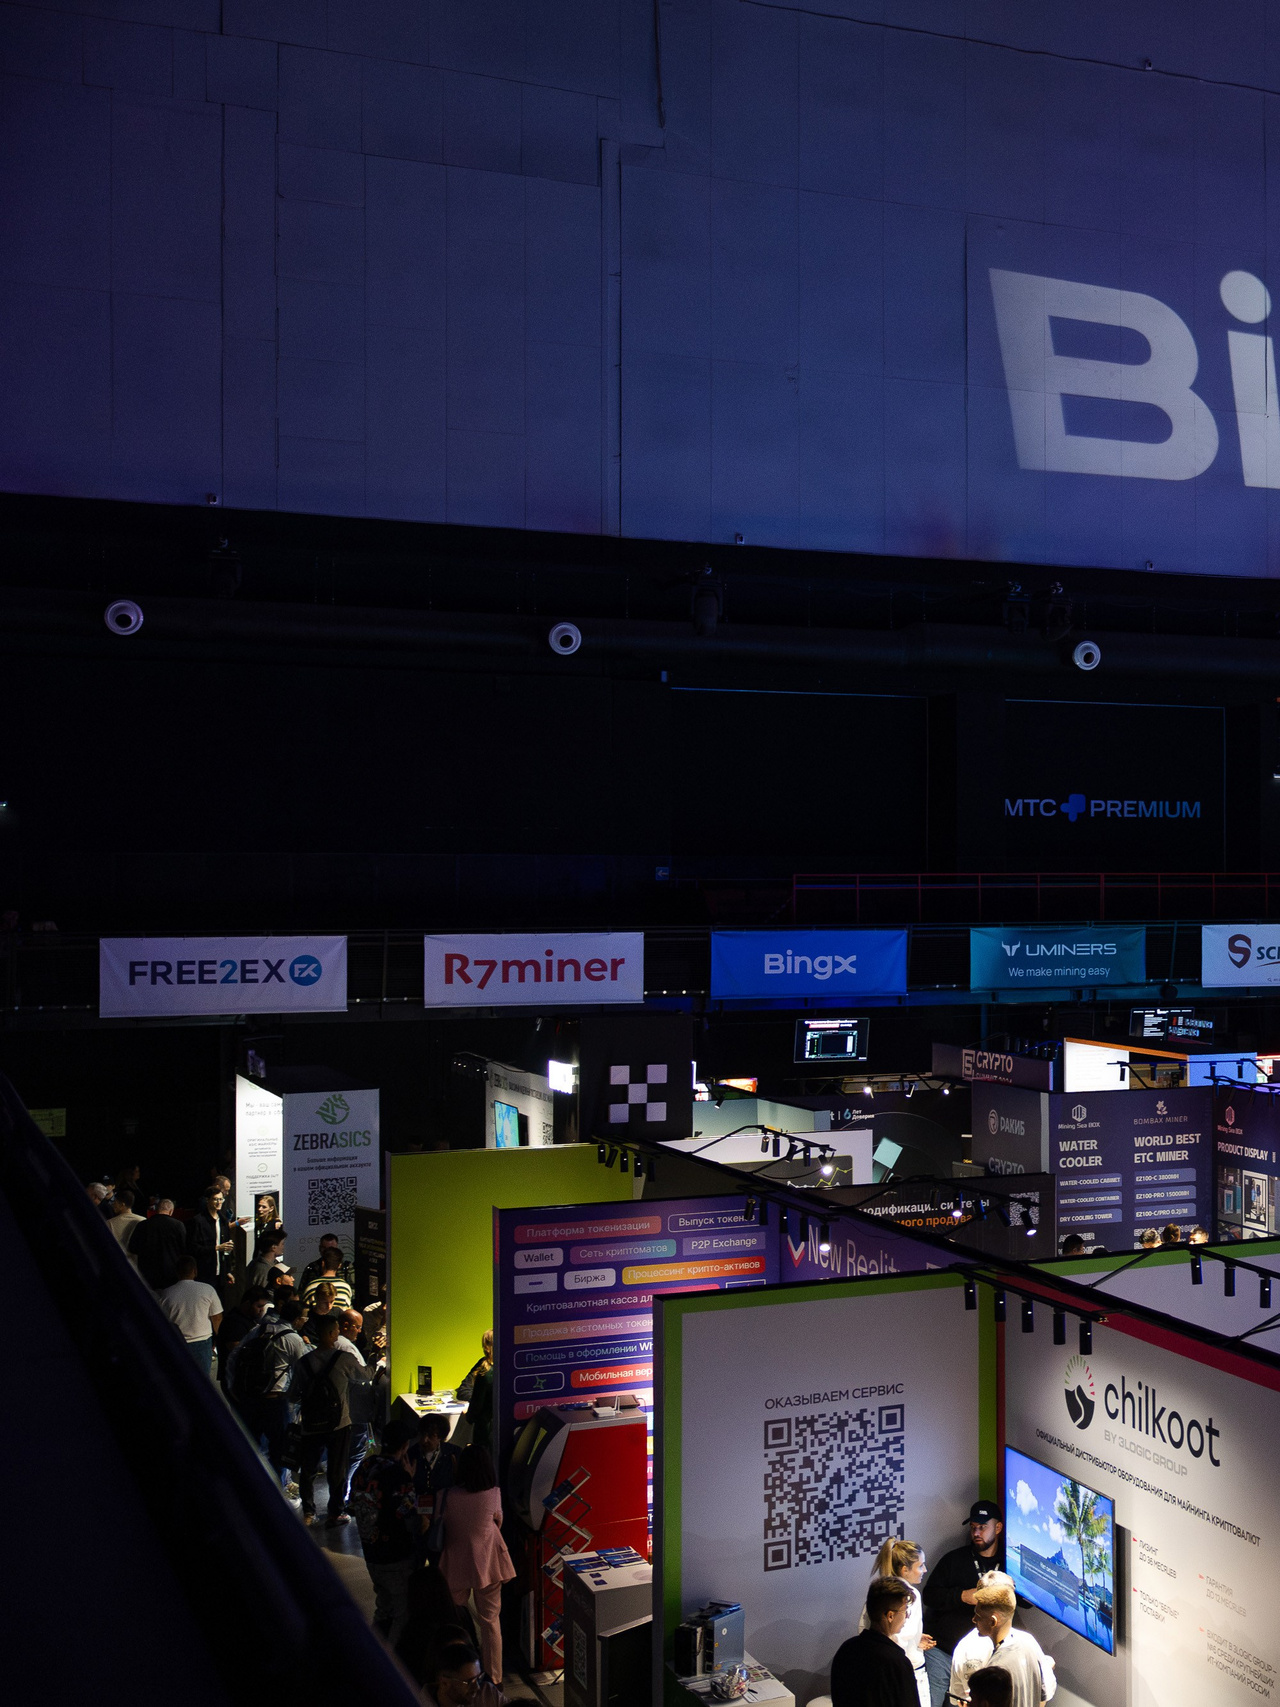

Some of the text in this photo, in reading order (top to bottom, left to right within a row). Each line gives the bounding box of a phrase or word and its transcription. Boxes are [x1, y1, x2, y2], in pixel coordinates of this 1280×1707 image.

[1090, 799, 1201, 818] PREMIUM
[1026, 943, 1118, 956] UMINERS
[129, 958, 287, 986] FREE2EX
[444, 948, 626, 991] R7miner
[764, 949, 858, 981] Bingx
[1008, 966, 1111, 979] We make mining easy
[976, 1051, 1013, 1073] CRYPTO
[1000, 1116, 1026, 1136] РАКИБ
[1133, 1115, 1189, 1125] BOMBAX MINER
[293, 1130, 372, 1151] ZEBRASICS
[1059, 1139, 1098, 1152] WATER
[1134, 1133, 1201, 1147] WORLD BEST
[1134, 1150, 1189, 1164] ETC MINER
[1217, 1141, 1269, 1161] PRODUCT DISPLAY
[1059, 1155, 1103, 1168] COOLER
[1060, 1178, 1100, 1187] WATER-COOLED
[1060, 1196, 1095, 1205] WATER-COOLED
[679, 1217, 715, 1227] Выпуск
[1060, 1215, 1071, 1223] DRY
[526, 1221, 651, 1238] Платформа токенизации
[579, 1244, 668, 1259] Сеть криптоматов
[691, 1237, 758, 1250] P2P Exchange
[524, 1252, 554, 1263] Wallet
[574, 1274, 606, 1284] Биржа
[628, 1261, 761, 1280] Процессинг крипто-активов
[526, 1296, 638, 1313] Криптовалютная касса
[523, 1327, 569, 1338] Продажа
[570, 1321, 623, 1334] кастомных
[525, 1351, 567, 1363] Помощь
[576, 1345, 637, 1359] оформлении
[579, 1369, 634, 1382] Мобильная
[764, 1382, 904, 1410] ОКАЗЫВАЕМ СЕРВИС
[1104, 1375, 1220, 1467] chilkoot
[1104, 1429, 1188, 1477] BY 3LOGIC GROUP
[1036, 1428, 1261, 1547] ОФИЦИАЛЬНЫЙ ДИСТРИБЬЮТОР ОБОРУДОВАНИЯ ДЛЯ МАЙНИНГА КРИПТОВАЛЮТ
[1139, 1539, 1159, 1556] ЛИЗИНГ
[1153, 1559, 1177, 1579] МЕСЯЦЕВ
[1206, 1575, 1234, 1596] ГАРАНТИЯ
[1140, 1590, 1159, 1608] ТОЛЬКО
[1220, 1595, 1247, 1618] МЕСЯЦЕВ
[1140, 1602, 1166, 1624] ПОСТАВКИ
[1206, 1629, 1273, 1674] ВХОДИТ 3LOGIC GROUP
[1207, 1656, 1271, 1699] ИТ-КОМПАНИЙ РОССИИ
[1217, 1648, 1275, 1689] СРЕДИ КРУПНЕЙШИХ
